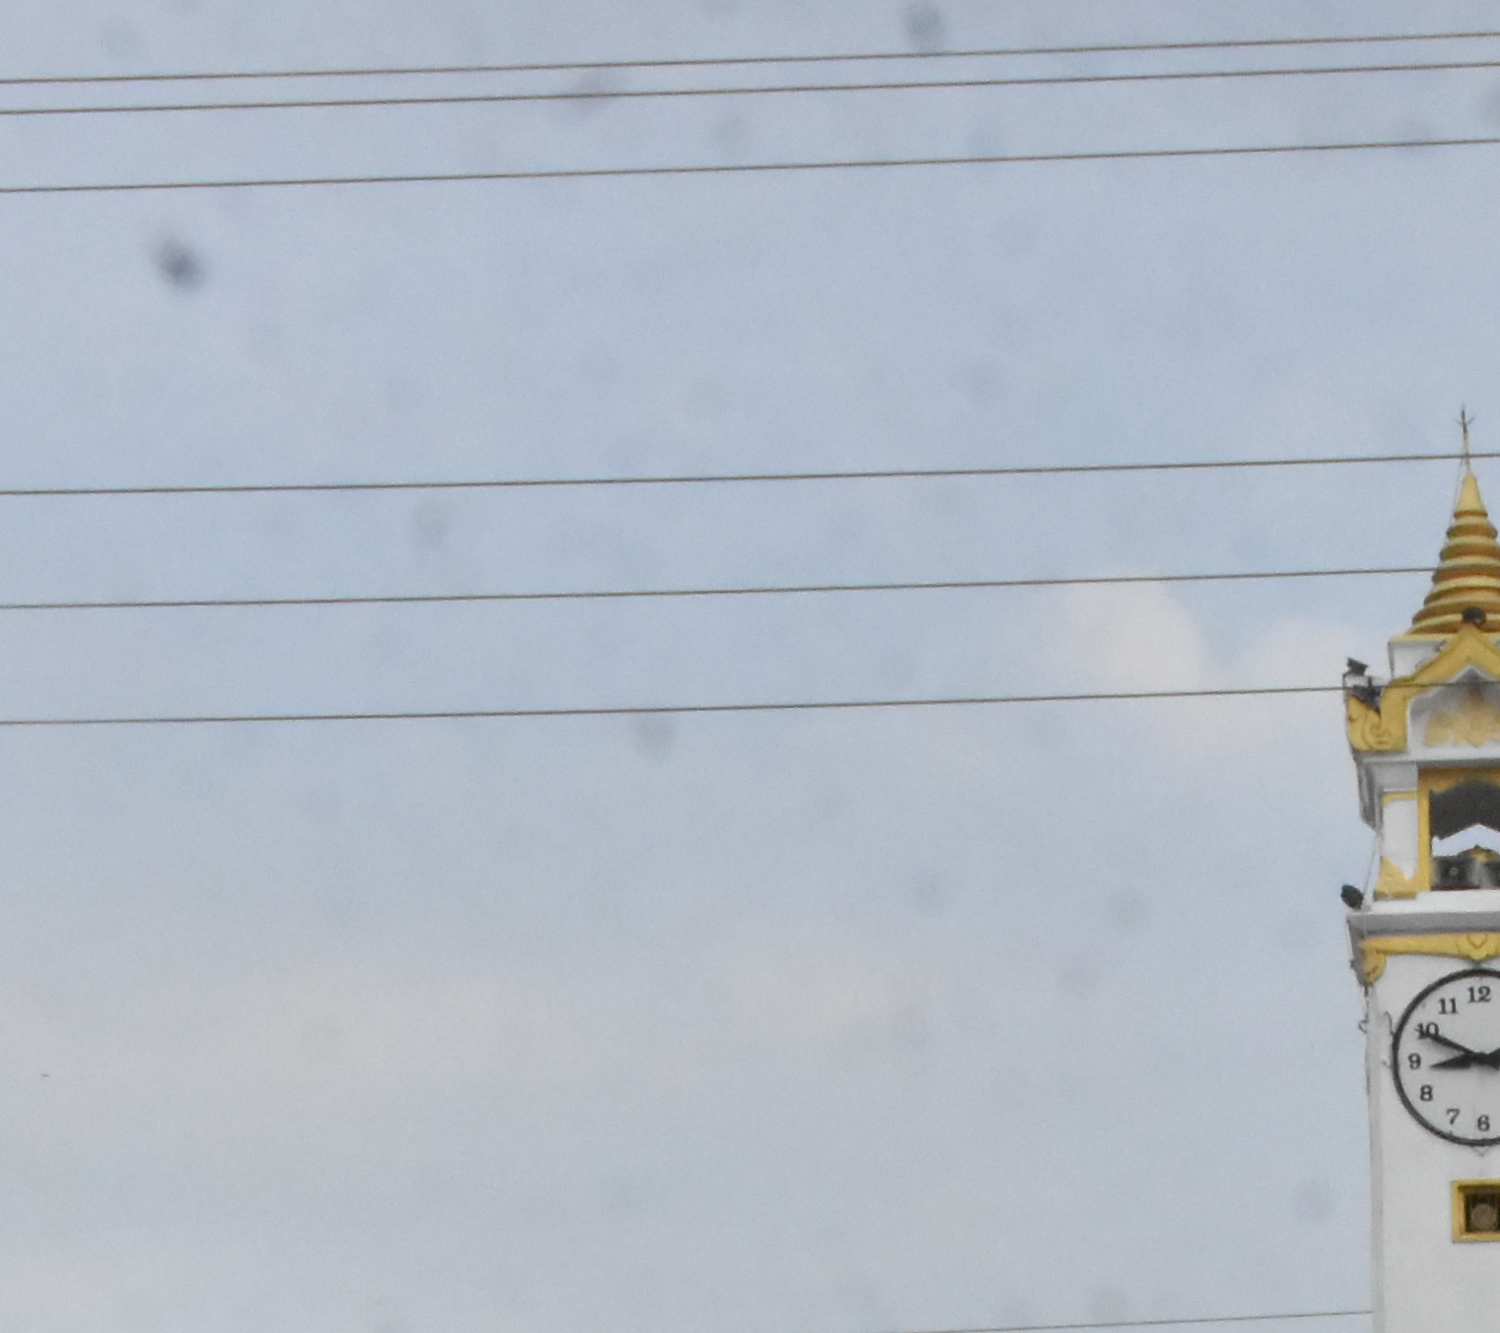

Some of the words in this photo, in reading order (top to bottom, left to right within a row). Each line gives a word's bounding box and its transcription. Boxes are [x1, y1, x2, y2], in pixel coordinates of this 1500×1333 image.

[1467, 986, 1491, 1003] 12
[1438, 998, 1458, 1014] 11
[1416, 1022, 1440, 1039] 10
[1408, 1053, 1421, 1070] 9
[1420, 1085, 1434, 1101] 8
[1446, 1108, 1460, 1125] 7
[1477, 1115, 1490, 1131] 6
